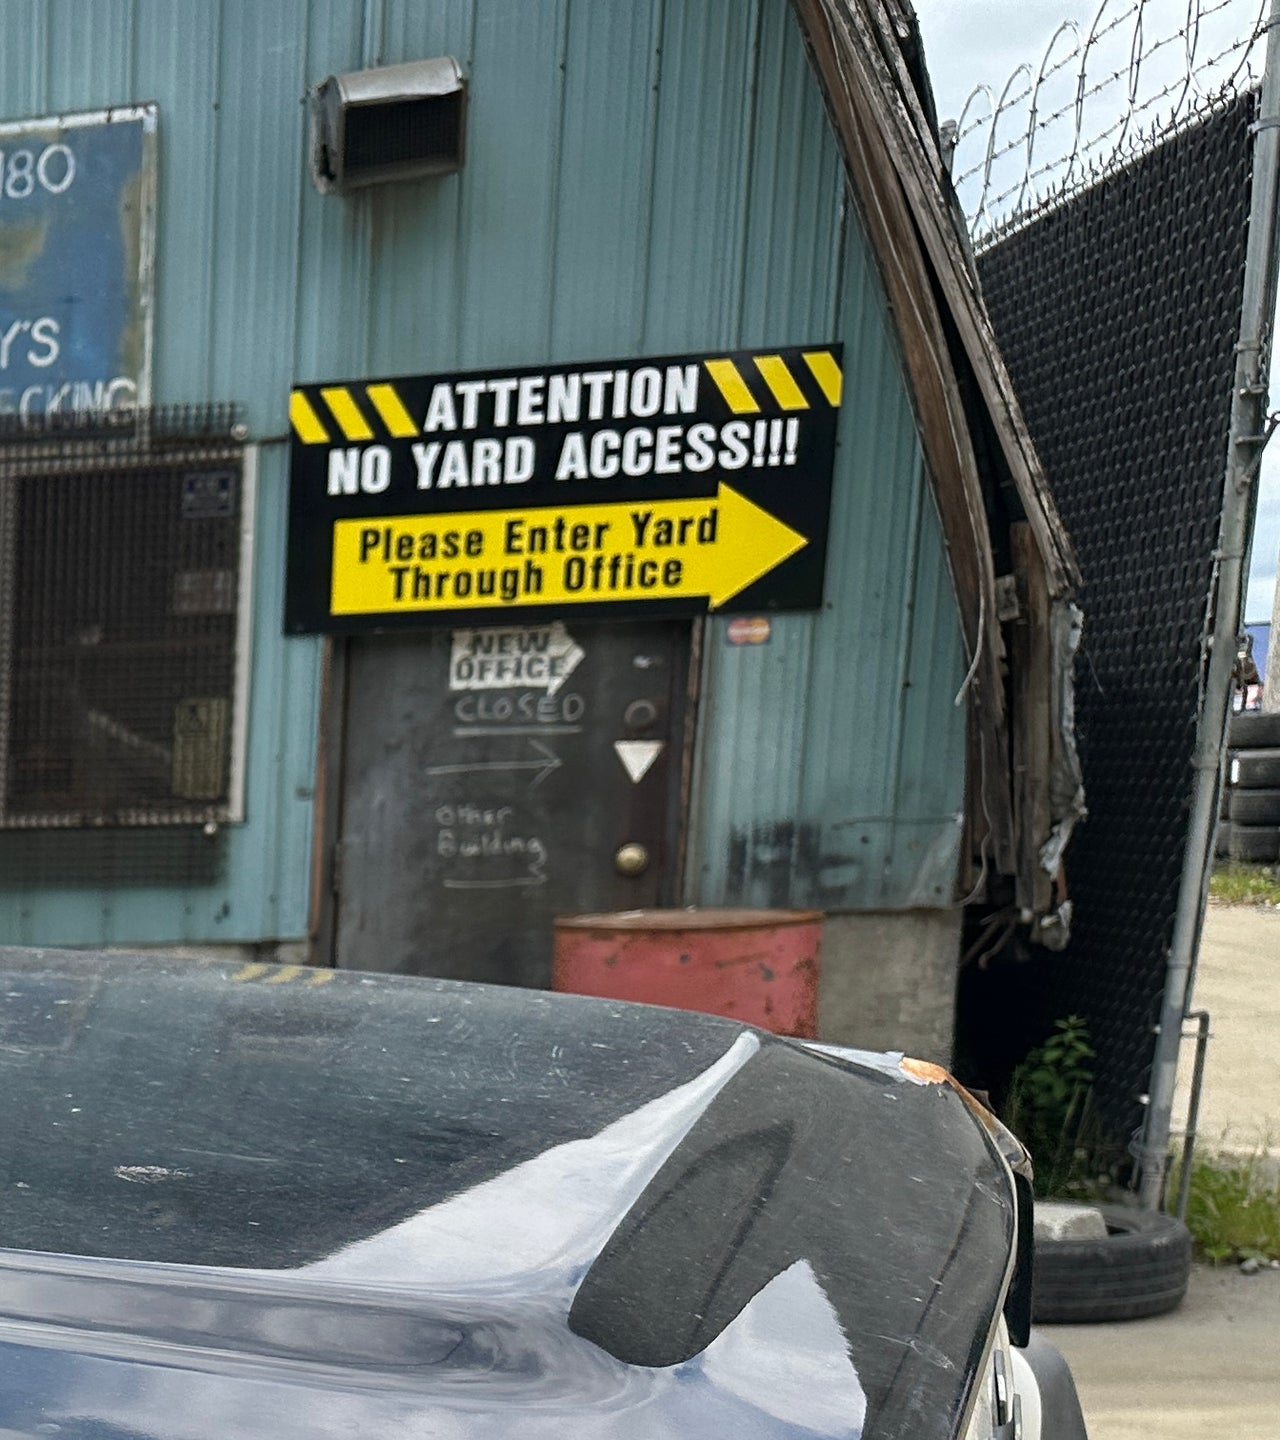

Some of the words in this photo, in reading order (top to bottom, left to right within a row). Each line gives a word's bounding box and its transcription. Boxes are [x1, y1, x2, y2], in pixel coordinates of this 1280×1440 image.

[423, 364, 699, 432] ATTENTION
[327, 446, 391, 496] NO
[412, 436, 536, 490] YARD
[555, 417, 800, 481] ACCESS!!!
[359, 528, 484, 563] Please
[504, 517, 609, 555] Enter
[631, 507, 718, 548] Yard
[390, 560, 542, 602] Through
[563, 553, 683, 592] Office
[470, 630, 551, 656] NEW
[456, 655, 569, 682] OFFICE
[455, 692, 585, 723] CLOSED
